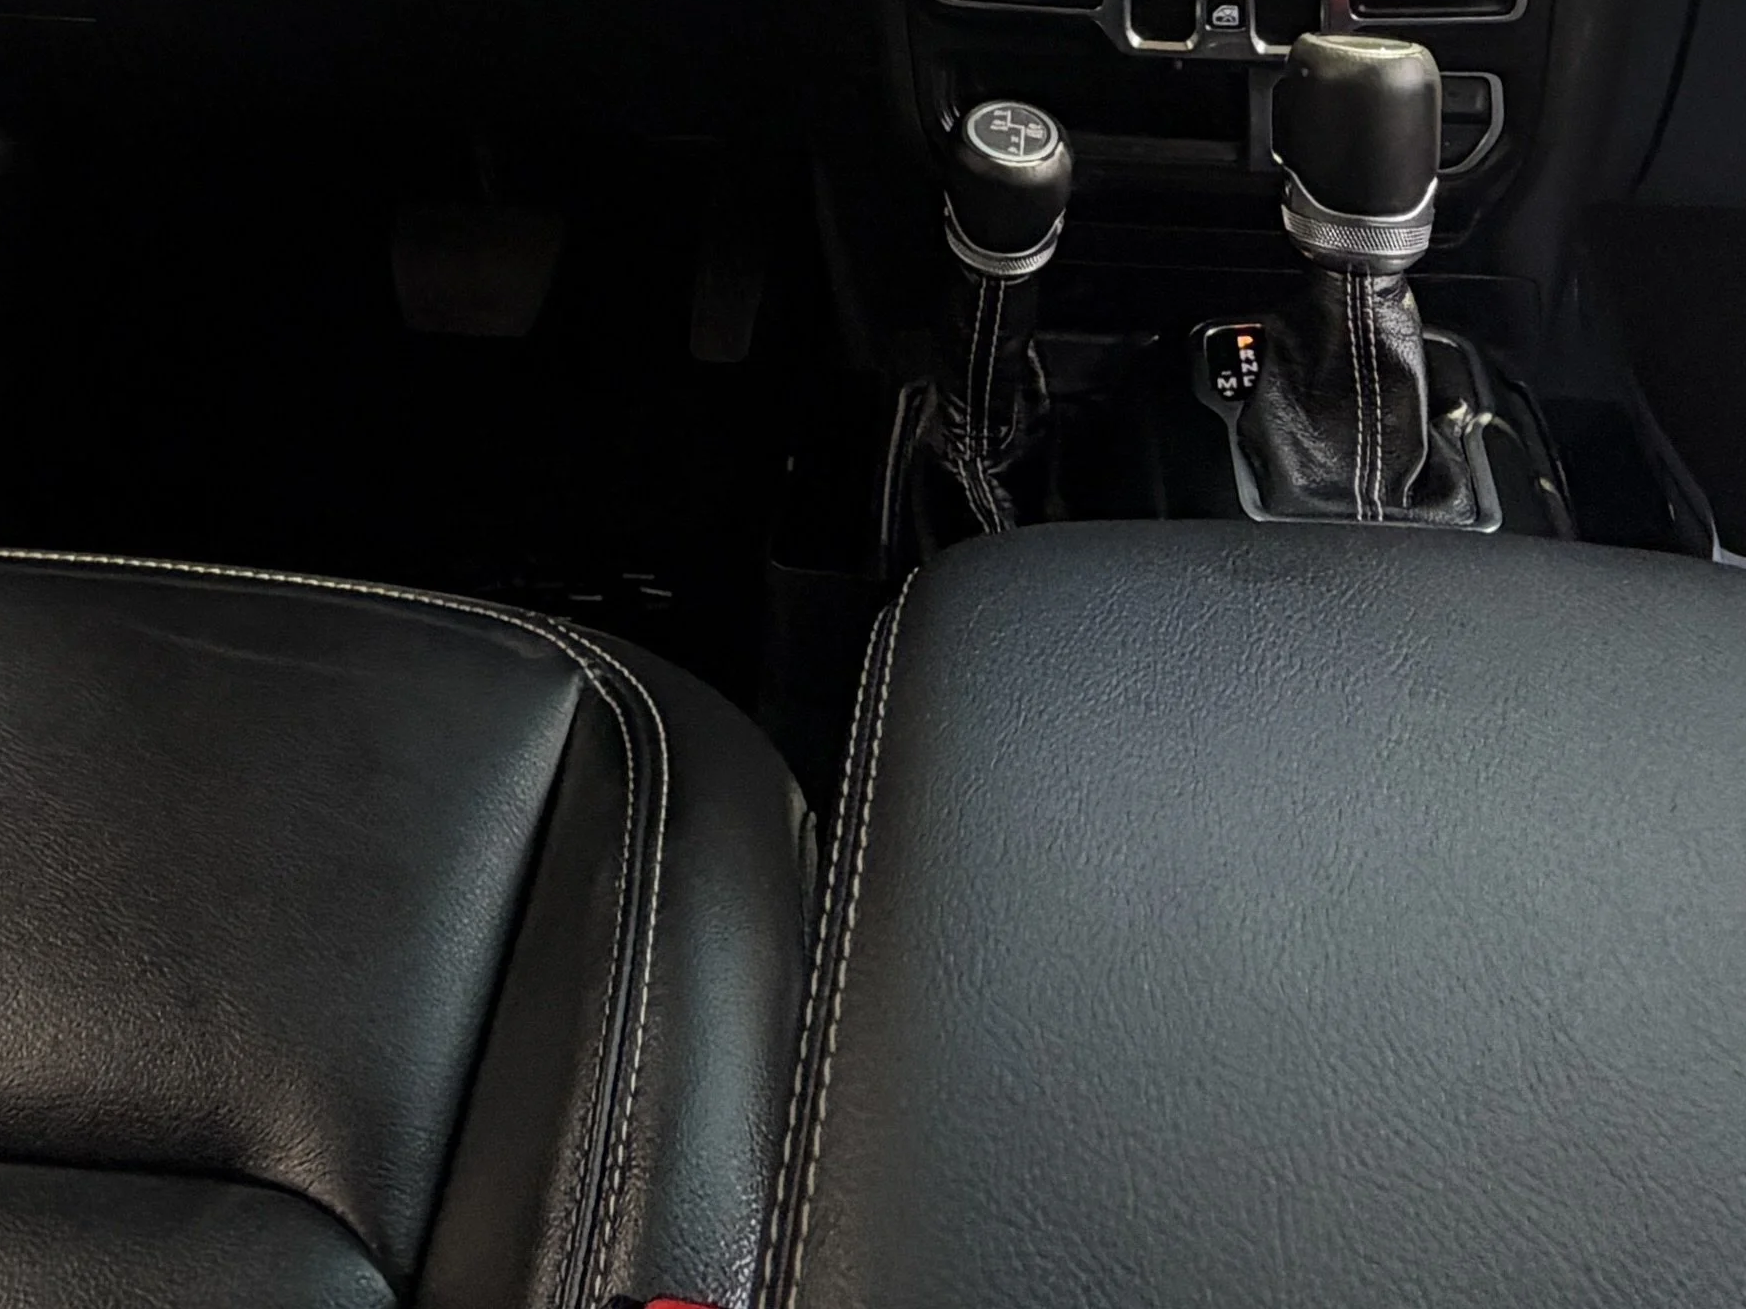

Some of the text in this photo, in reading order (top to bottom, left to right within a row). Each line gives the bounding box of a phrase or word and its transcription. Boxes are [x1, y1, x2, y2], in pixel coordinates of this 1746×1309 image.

[1237, 335, 1253, 349] P
[1239, 349, 1255, 361] R
[1241, 361, 1259, 373] N
[1217, 376, 1238, 389] M
